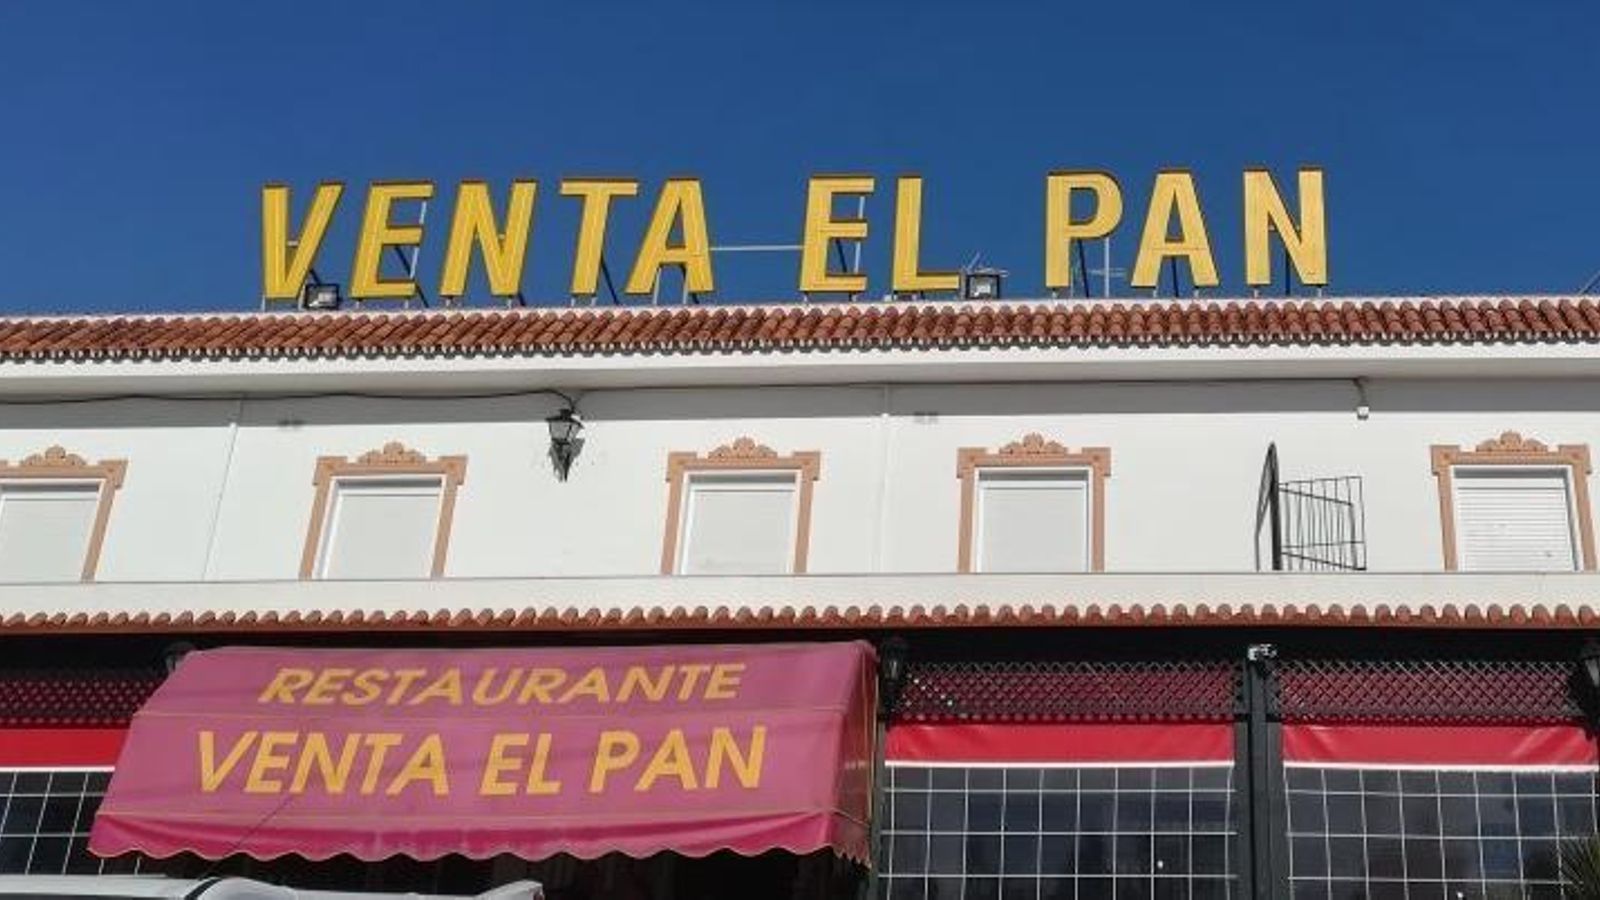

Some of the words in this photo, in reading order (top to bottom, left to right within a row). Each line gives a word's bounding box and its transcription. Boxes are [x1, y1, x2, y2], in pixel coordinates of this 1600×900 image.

[262, 179, 715, 300] VENTA
[799, 174, 962, 293] EL
[1045, 167, 1329, 290] PAN
[258, 663, 745, 707] RESTAURANTE
[197, 730, 449, 797] VENTA
[480, 731, 563, 797] EL
[589, 725, 767, 795] PAN
